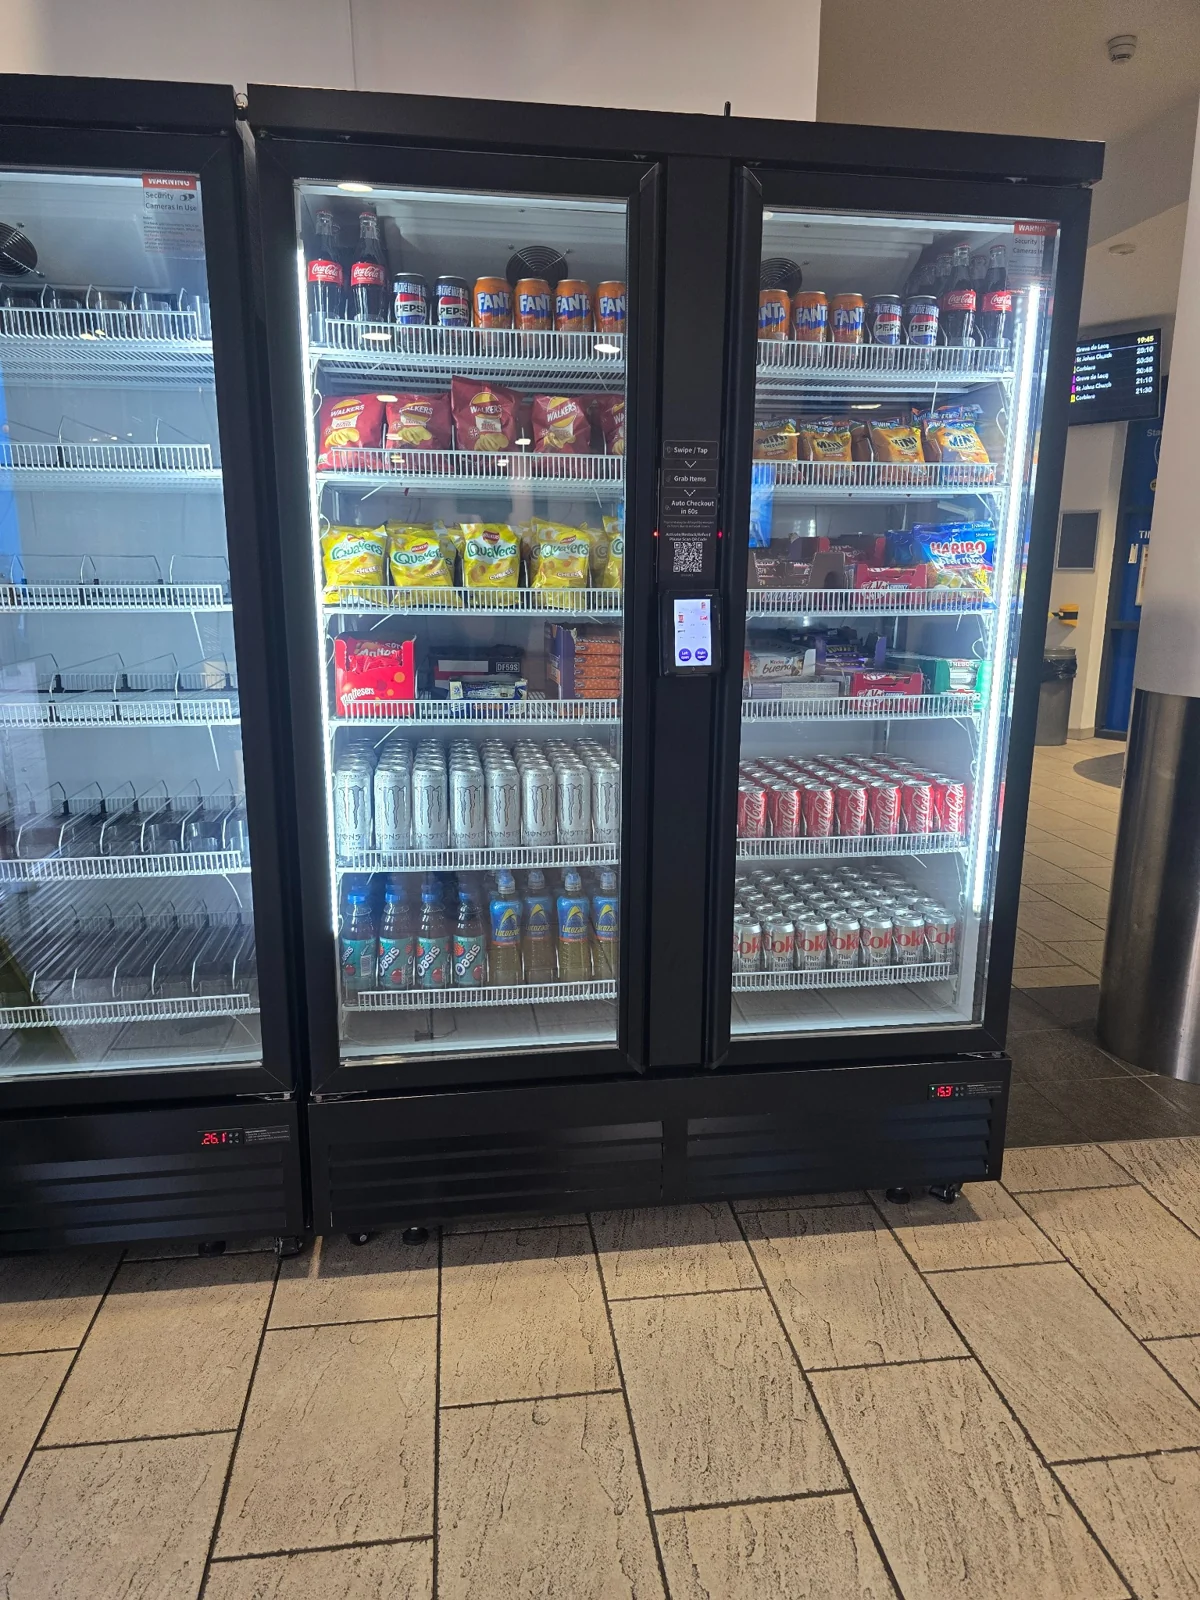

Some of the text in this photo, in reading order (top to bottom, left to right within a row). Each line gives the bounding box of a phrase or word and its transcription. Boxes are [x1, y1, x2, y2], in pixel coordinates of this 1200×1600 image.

[148, 178, 190, 187] WARNING
[145, 191, 174, 201] Security
[145, 202, 175, 211] Cameras
[311, 263, 338, 276] Coca-Cola
[353, 266, 380, 278] Coca-Cola
[477, 292, 512, 315] FANT
[519, 294, 550, 316] FANT
[600, 295, 625, 314] FAN
[759, 303, 786, 321] NTA
[796, 304, 828, 324] FANT
[833, 306, 865, 326] FANT
[1137, 335, 1154, 344] 19:45
[1135, 366, 1153, 375] 20:45
[1135, 376, 1153, 385] 21:10
[1135, 386, 1153, 395] 21:30
[330, 404, 365, 418] WALKERS
[546, 401, 578, 423] WALKERS
[1147, 428, 1162, 437] Sta
[697, 447, 709, 455] Tap
[331, 541, 384, 560] Quavers
[466, 541, 517, 559] Quavers
[930, 541, 987, 556] HARIBO
[393, 547, 443, 565] Quaver
[557, 571, 583, 579] CHEES
[762, 664, 792, 675] bueno
[417, 946, 441, 977] Oasis
[455, 944, 481, 976] Oasis
